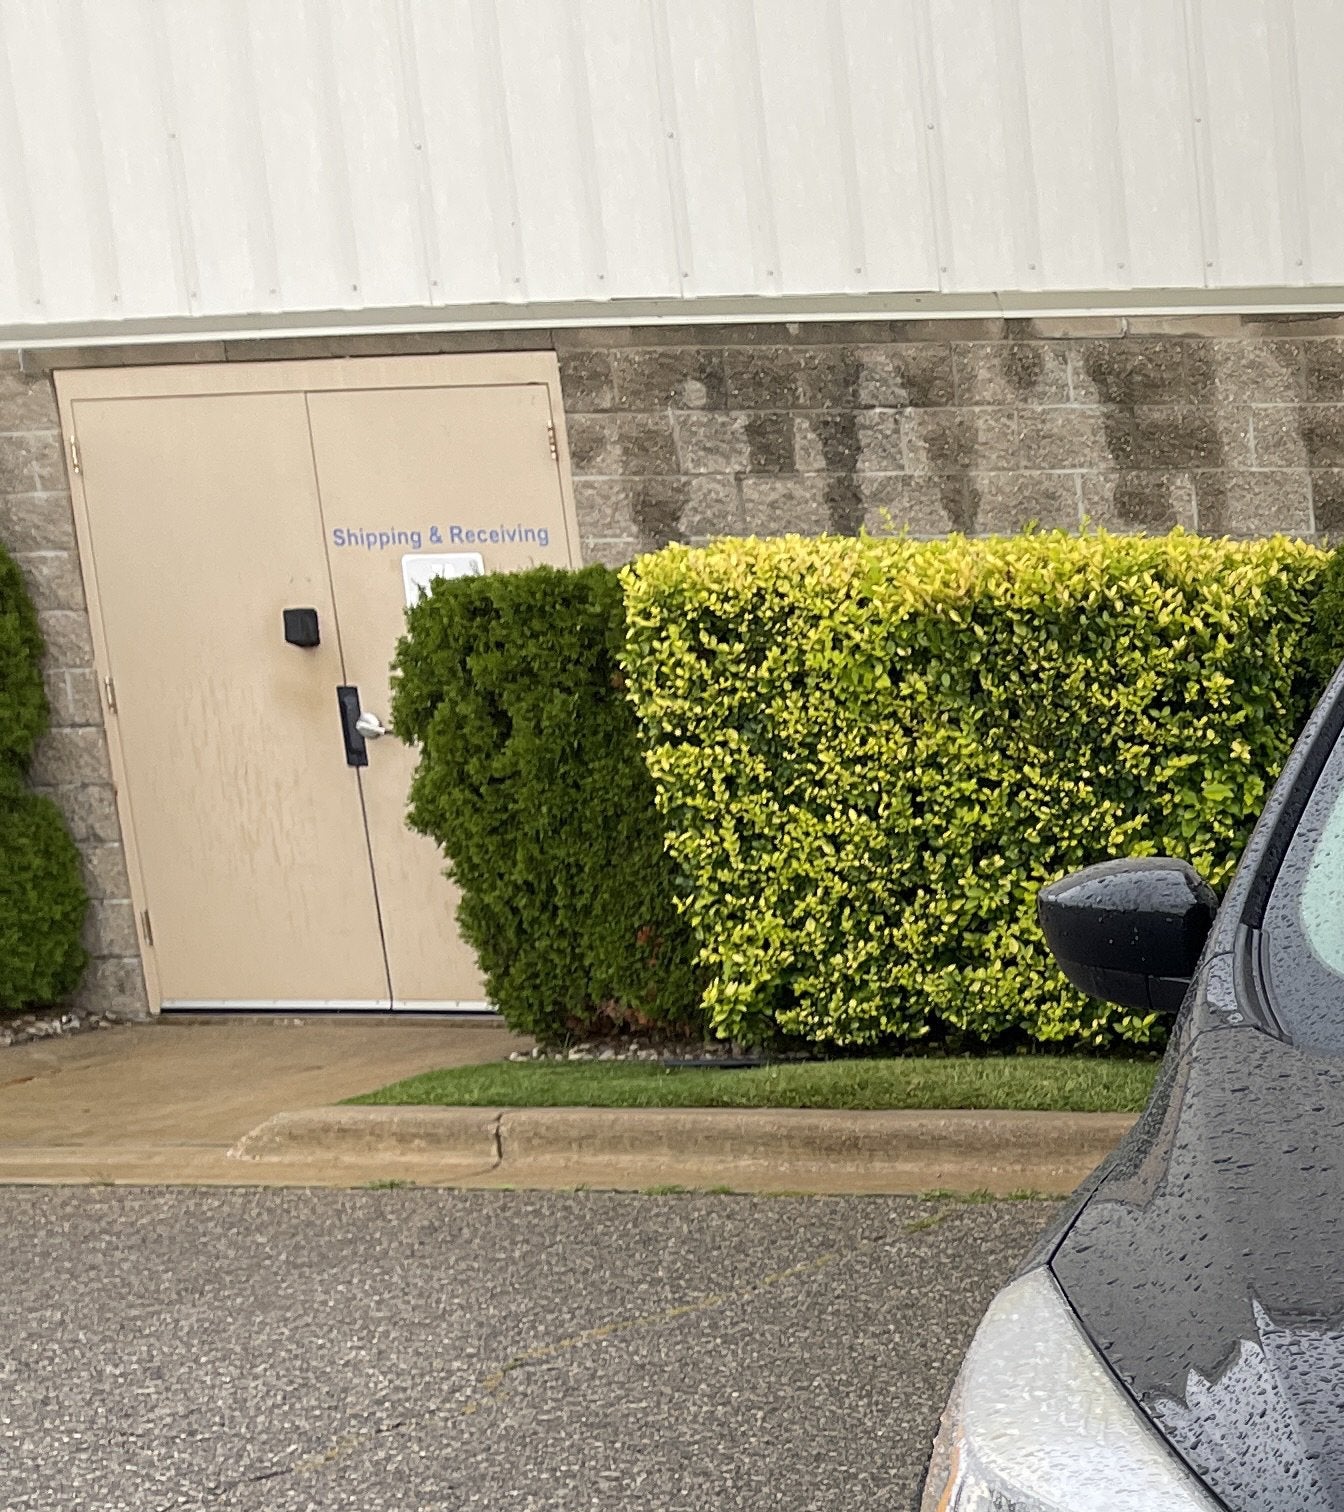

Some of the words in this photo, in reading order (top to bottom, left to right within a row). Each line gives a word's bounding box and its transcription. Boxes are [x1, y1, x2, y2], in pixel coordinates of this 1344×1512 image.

[332, 528, 422, 550] Shipping
[429, 525, 443, 545] &
[449, 524, 550, 547] Receiving
